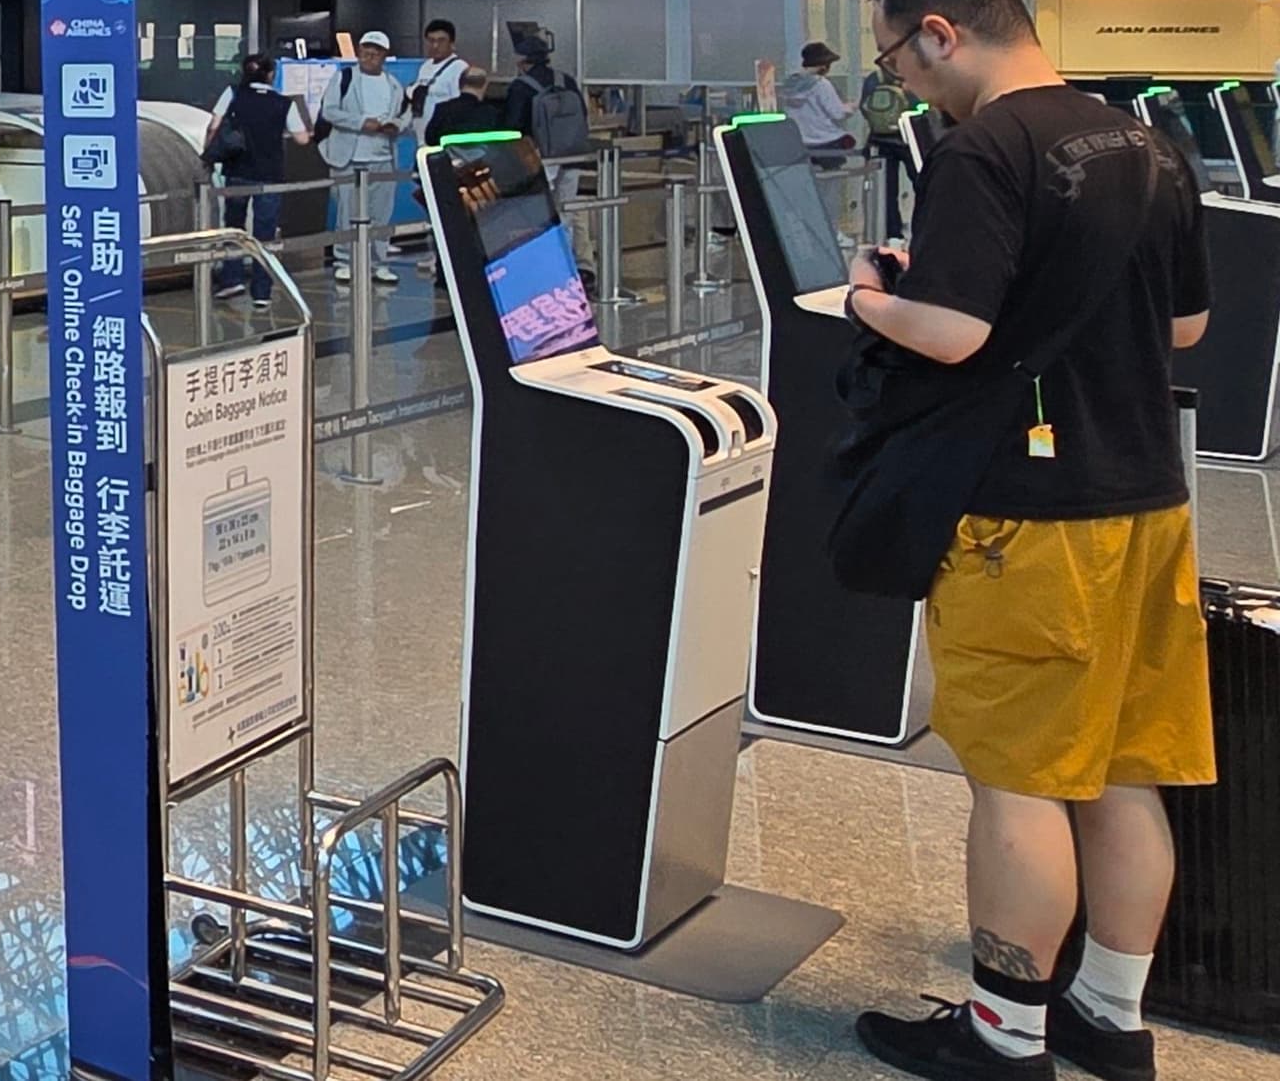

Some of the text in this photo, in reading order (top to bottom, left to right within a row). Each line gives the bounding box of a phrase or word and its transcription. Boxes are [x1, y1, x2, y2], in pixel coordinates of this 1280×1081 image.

[65, 27, 111, 37] AIRLINES
[71, 19, 105, 29] CHINA
[1096, 26, 1220, 34] JAPAN AIRLINES
[61, 205, 82, 248] Self
[91, 206, 123, 276] 自助
[62, 269, 85, 340] Online
[64, 346, 87, 445] Check-in
[92, 316, 128, 453] 網路報到
[185, 350, 288, 403] 手提行李須知
[185, 388, 288, 429] Cabin Baggage Notice
[66, 452, 87, 550] Baggage
[96, 476, 132, 617] 行李託運
[68, 557, 89, 611] Drop
